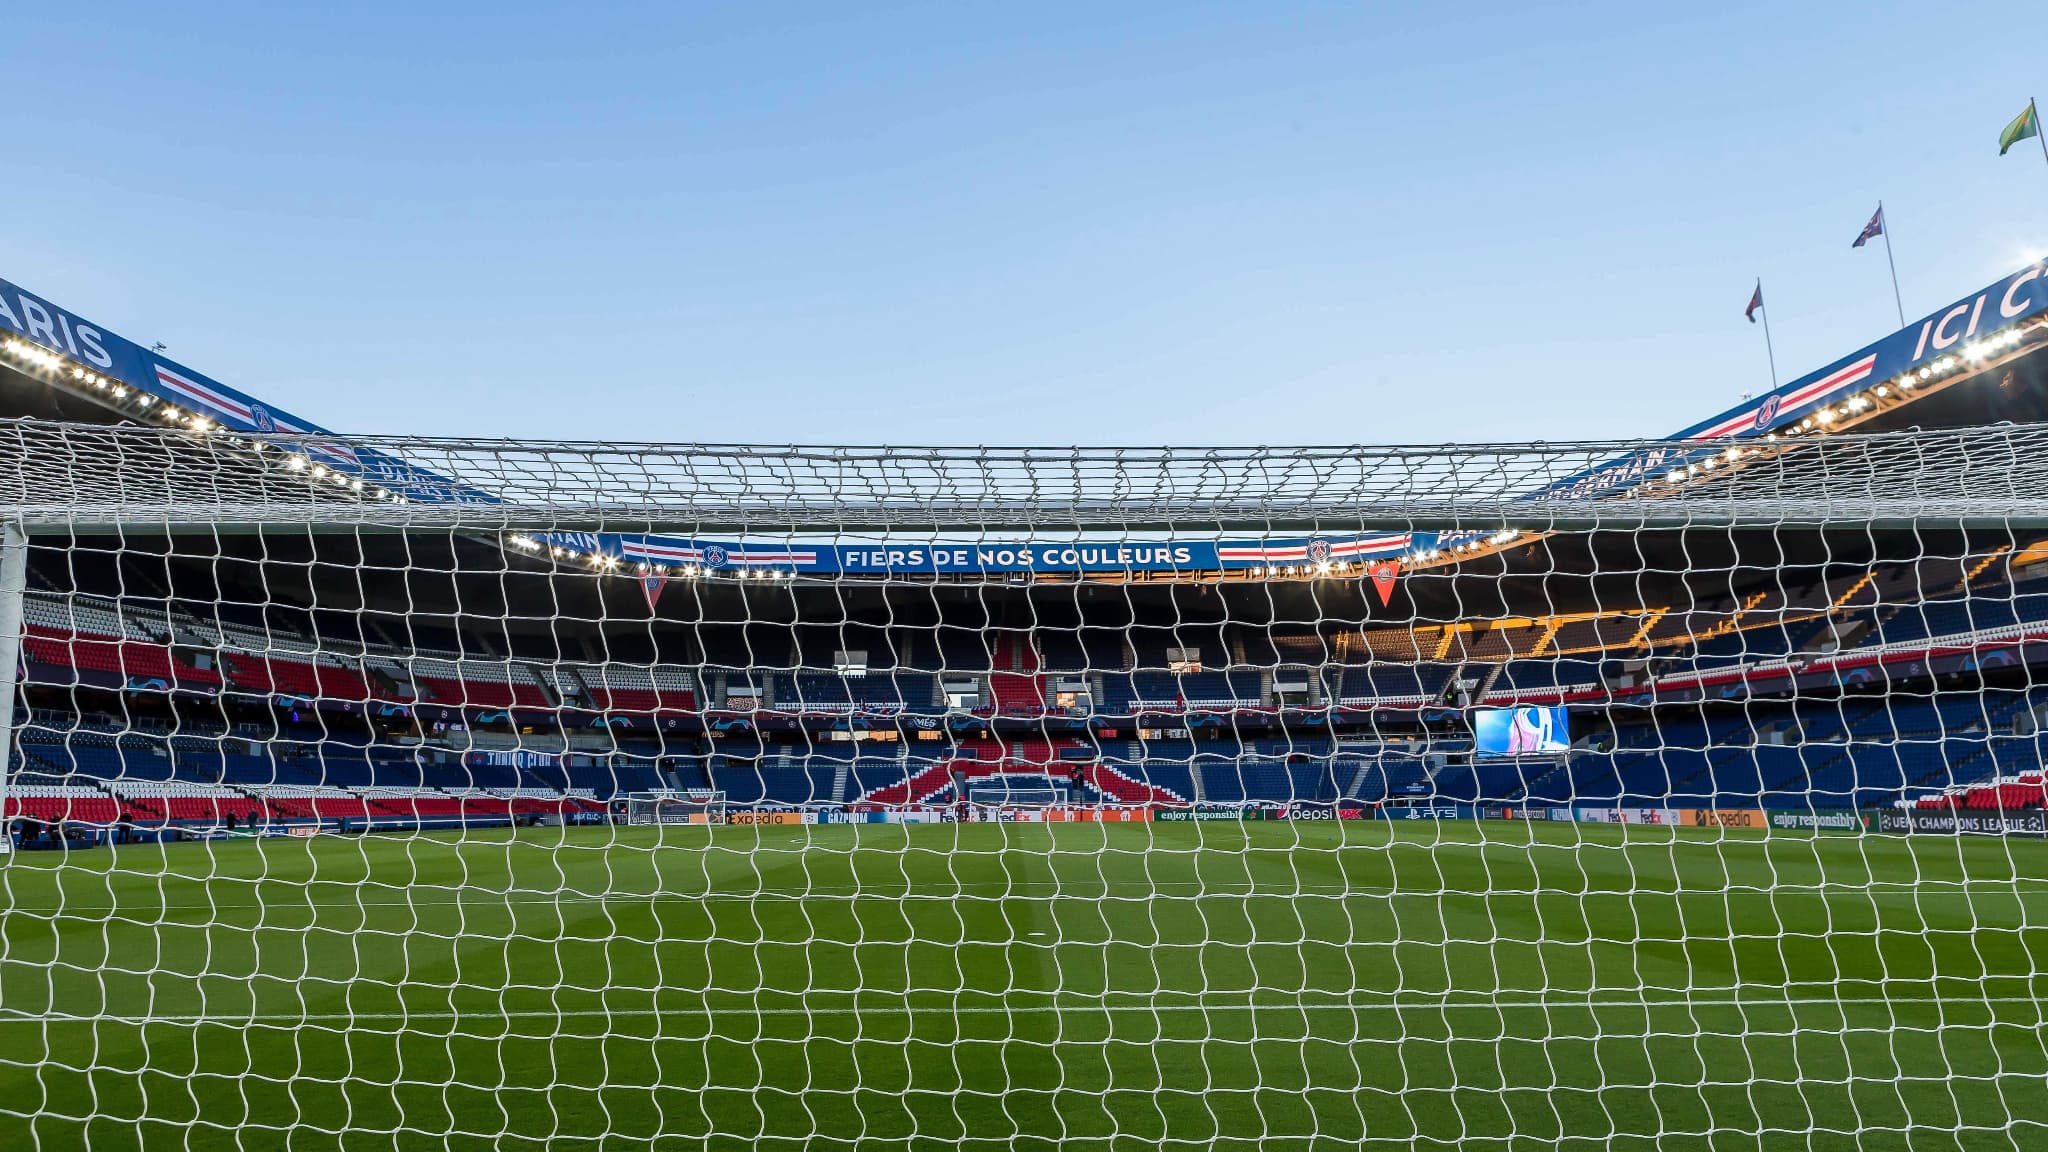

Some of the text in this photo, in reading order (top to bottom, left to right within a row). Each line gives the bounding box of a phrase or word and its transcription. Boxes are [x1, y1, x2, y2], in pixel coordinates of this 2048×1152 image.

[1912, 294, 1987, 361] ICI
[845, 547, 1192, 567] FIERS DE NOS COULEURS
[1161, 811, 1187, 821] enjoy
[1292, 808, 1333, 820] pepsi
[1710, 810, 1751, 827] Expedia
[1774, 812, 1856, 830] enjoy responsibly
[1892, 817, 2025, 831] UEFA CHAMPONS LEAGUE
